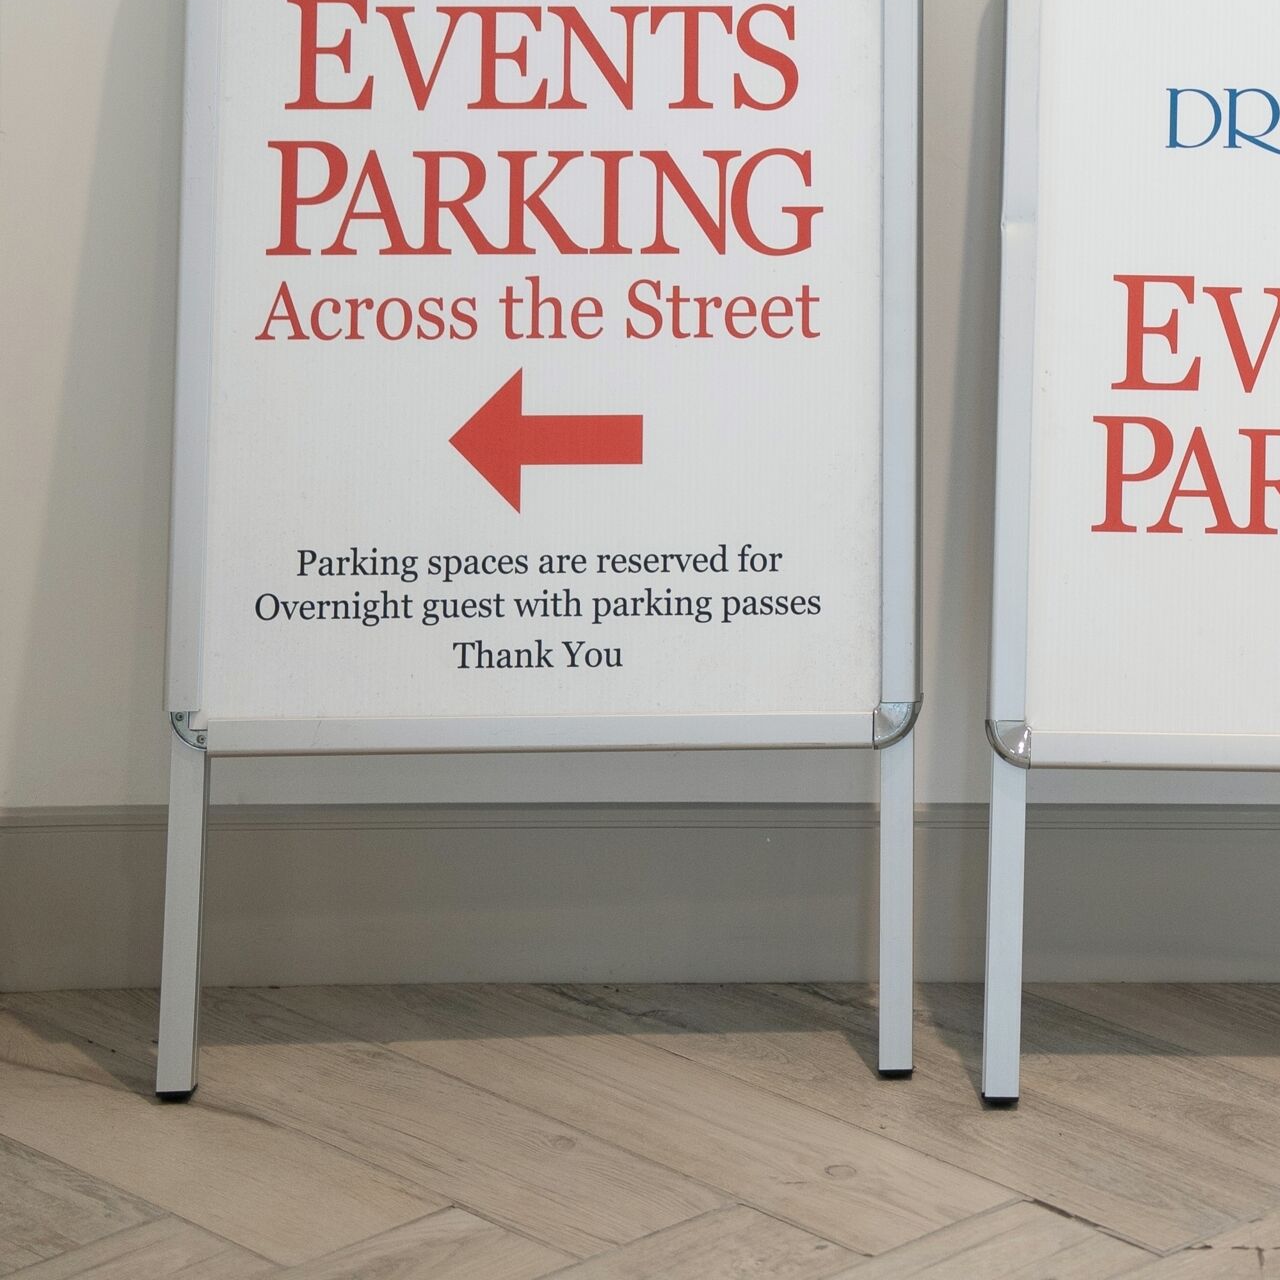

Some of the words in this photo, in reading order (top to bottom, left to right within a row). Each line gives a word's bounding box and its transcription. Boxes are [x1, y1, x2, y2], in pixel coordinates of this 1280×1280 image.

[266, 141, 823, 256] PARKING
[255, 281, 477, 340] Across
[499, 276, 603, 339] the
[627, 279, 820, 339] Street
[297, 547, 418, 581] Parking
[428, 555, 528, 581] spaces
[539, 555, 586, 574] are
[597, 544, 728, 573] reserved
[738, 544, 782, 572] for
[255, 590, 413, 625] Overnight
[422, 594, 505, 624] guest
[514, 589, 582, 617] with
[592, 588, 712, 623] parking
[722, 596, 821, 621] passes
[453, 640, 554, 668] Thank
[562, 641, 623, 667] You
